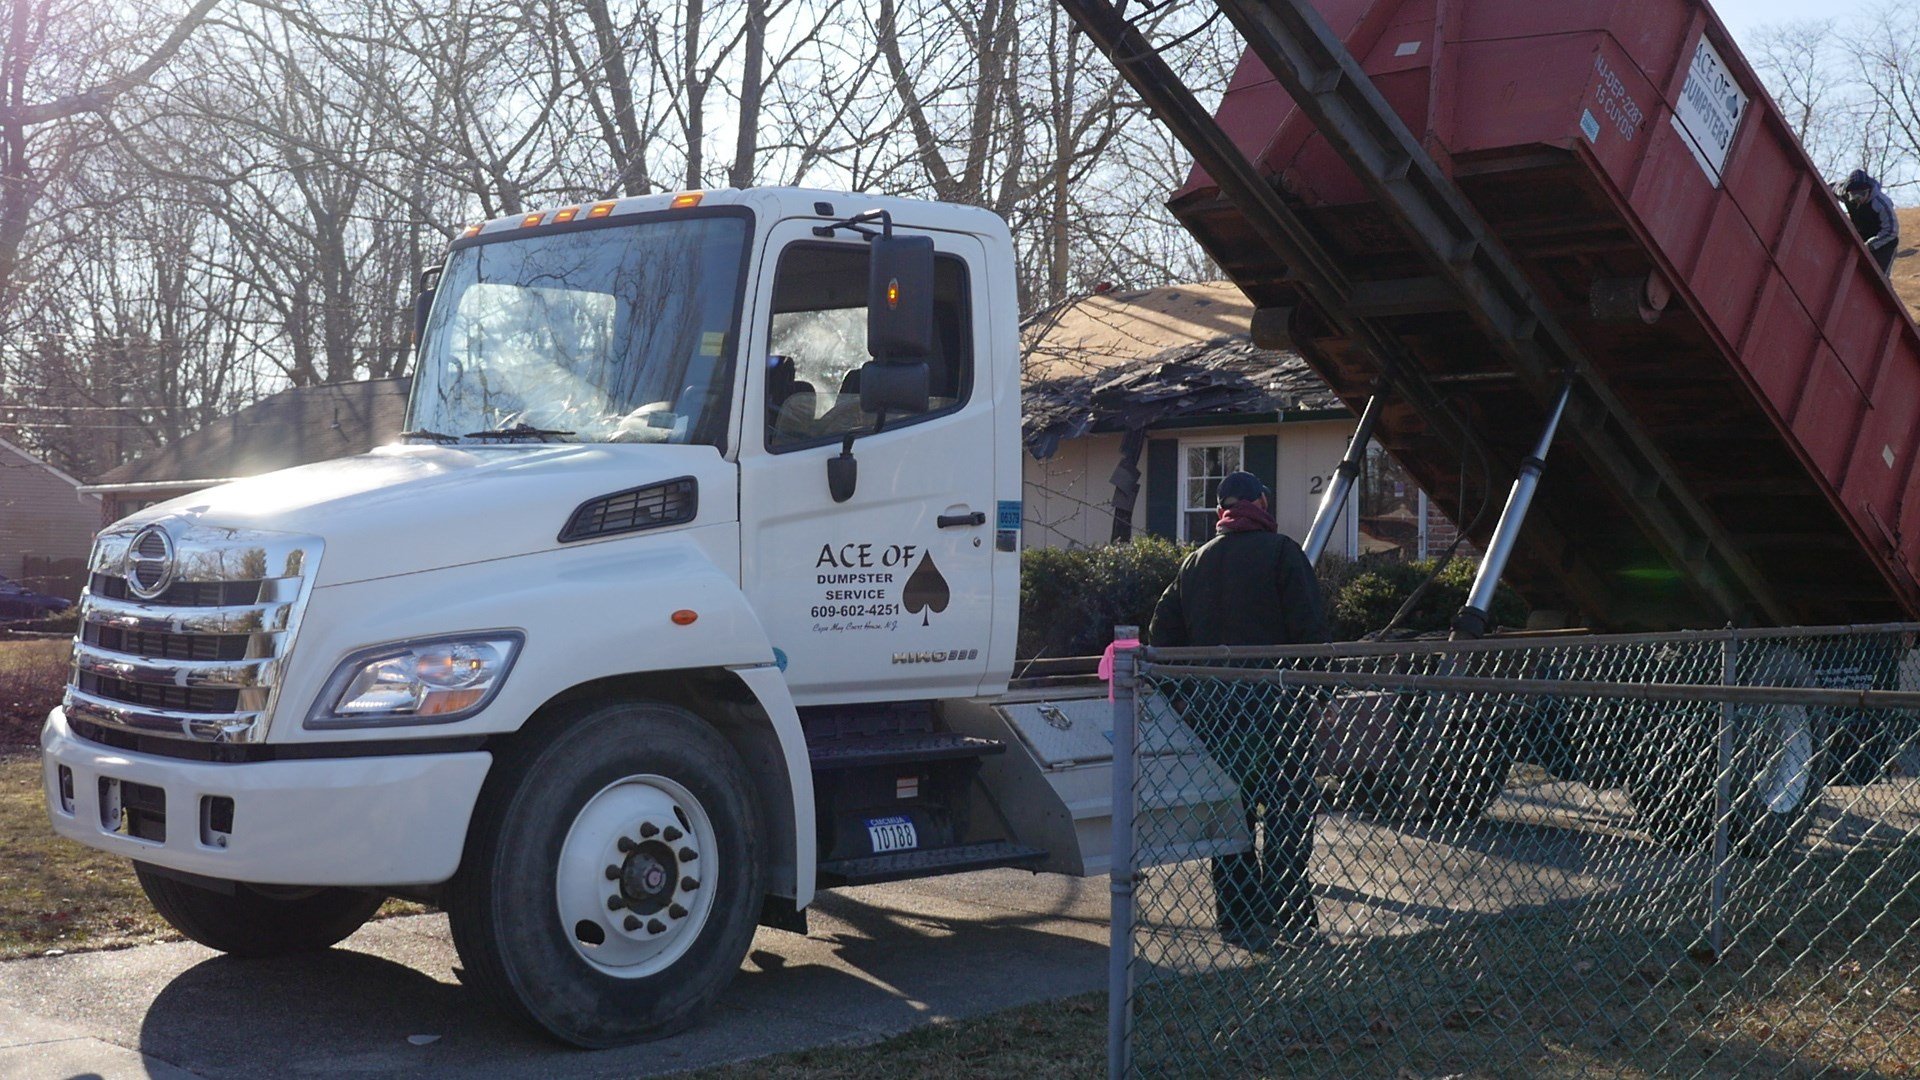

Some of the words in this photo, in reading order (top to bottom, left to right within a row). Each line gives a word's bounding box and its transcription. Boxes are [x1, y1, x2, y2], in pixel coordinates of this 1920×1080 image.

[1695, 43, 1716, 83] ACE
[1714, 73, 1731, 100] OF
[1595, 84, 1606, 104] 15
[816, 544, 872, 568] ACE
[882, 545, 917, 568] OF
[817, 573, 893, 584] DUMPSTER
[825, 589, 885, 601] SERVICE
[811, 604, 900, 618] 609-602-4251
[813, 623, 829, 634] Cape
[830, 623, 844, 633] May
[874, 824, 913, 850] 10188
